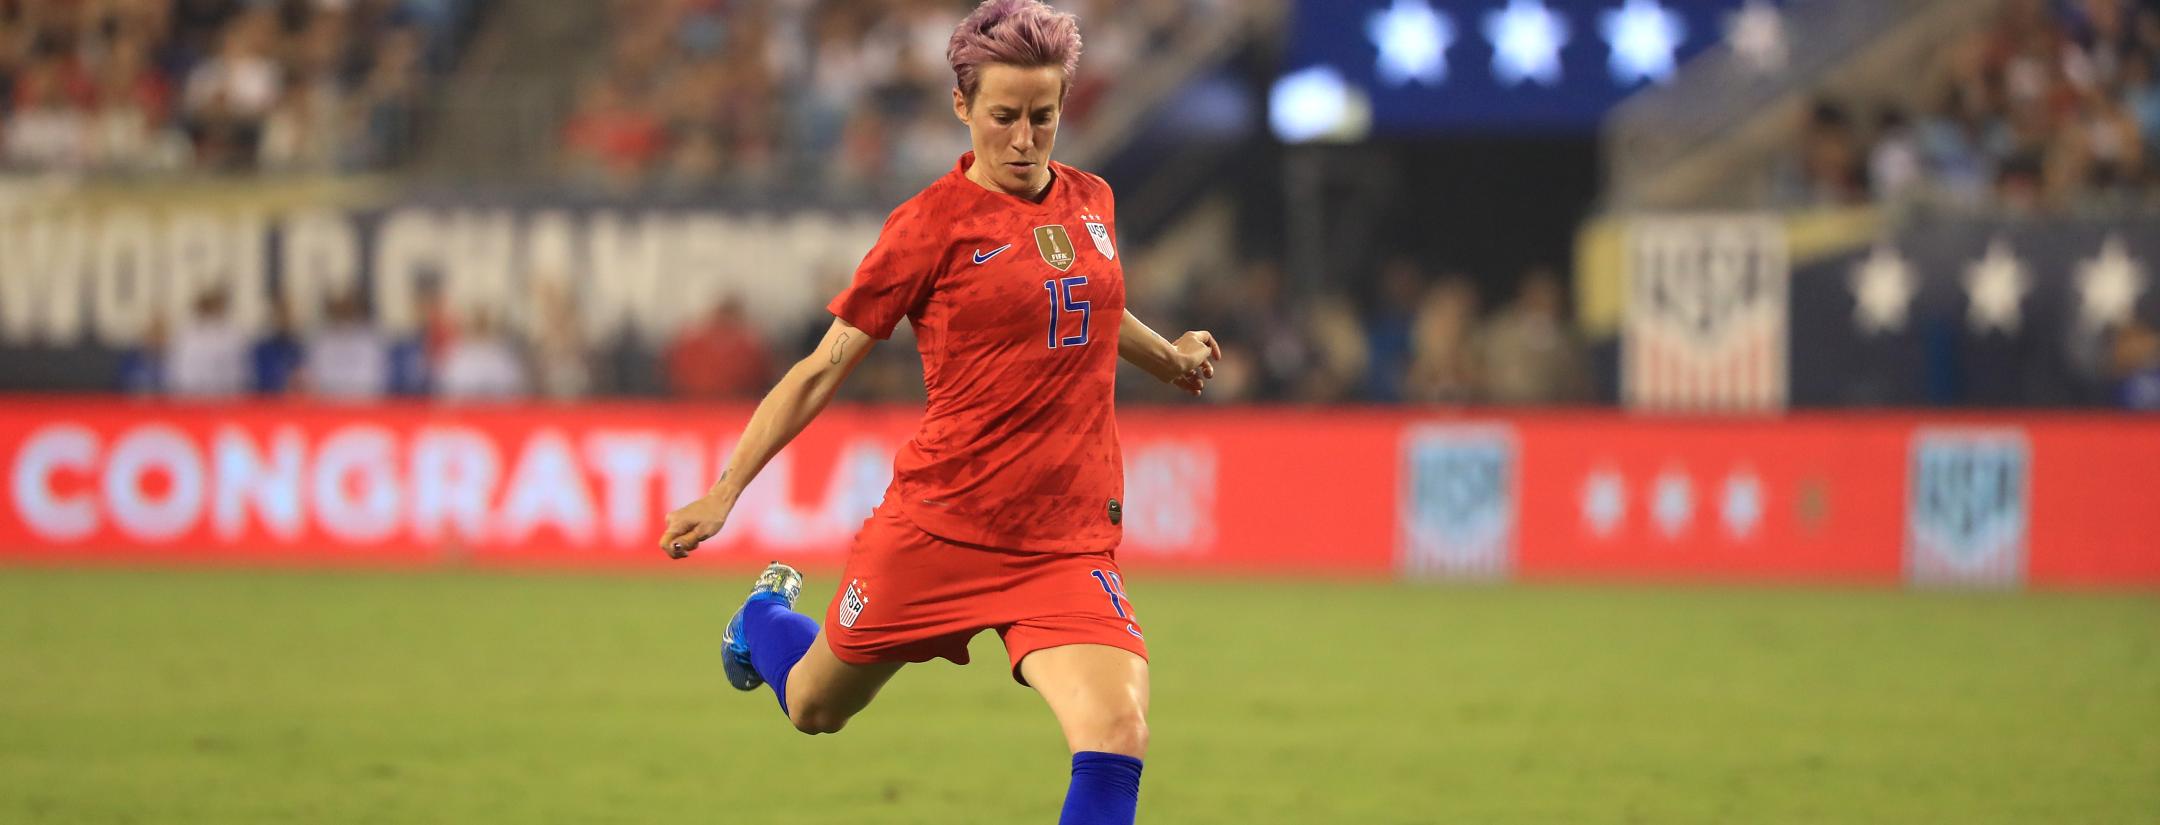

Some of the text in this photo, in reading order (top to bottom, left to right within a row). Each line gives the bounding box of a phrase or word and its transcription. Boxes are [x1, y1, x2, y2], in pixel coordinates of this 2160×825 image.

[1088, 224, 1106, 239] USA
[1051, 252, 1068, 260] FIFA
[1044, 276, 1090, 349] 15
[10, 422, 897, 547] CONGRATULA
[847, 587, 862, 613] USA
